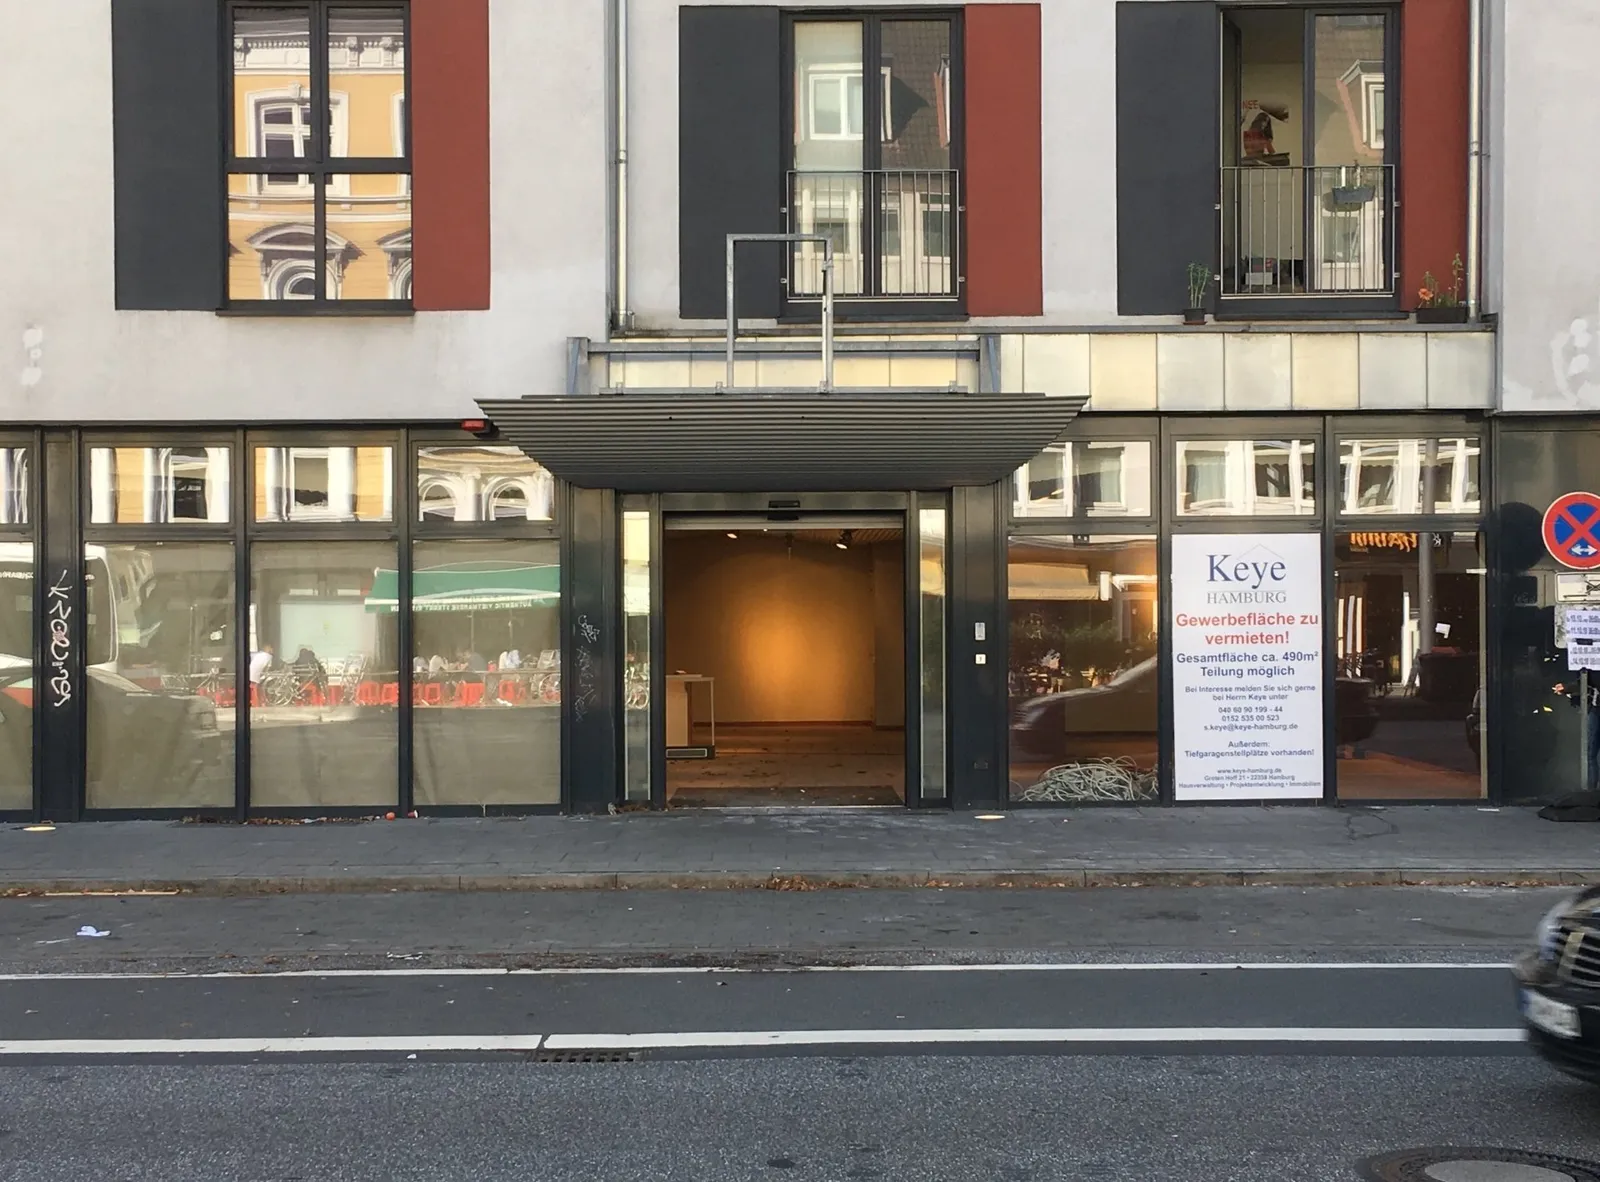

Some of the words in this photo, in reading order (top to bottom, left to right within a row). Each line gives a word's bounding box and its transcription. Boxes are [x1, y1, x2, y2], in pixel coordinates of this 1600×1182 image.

[1207, 554, 1286, 589] Keye
[1207, 591, 1287, 604] HAMBURG
[1176, 612, 1295, 626] Gewerbefläche
[1300, 614, 1318, 625] zu
[1206, 631, 1290, 645] vermieten!
[1176, 652, 1258, 663] Gesamtfläche
[1262, 654, 1278, 662] ca.
[1282, 651, 1318, 662] 490m²
[1201, 666, 1244, 678] Teilung
[1247, 666, 1295, 678] möglich
[1248, 694, 1267, 702] Keye
[1204, 722, 1298, 732] s.keye@keye-hamburg.de
[1184, 750, 1268, 758] Tiefgaragenstellplätze
